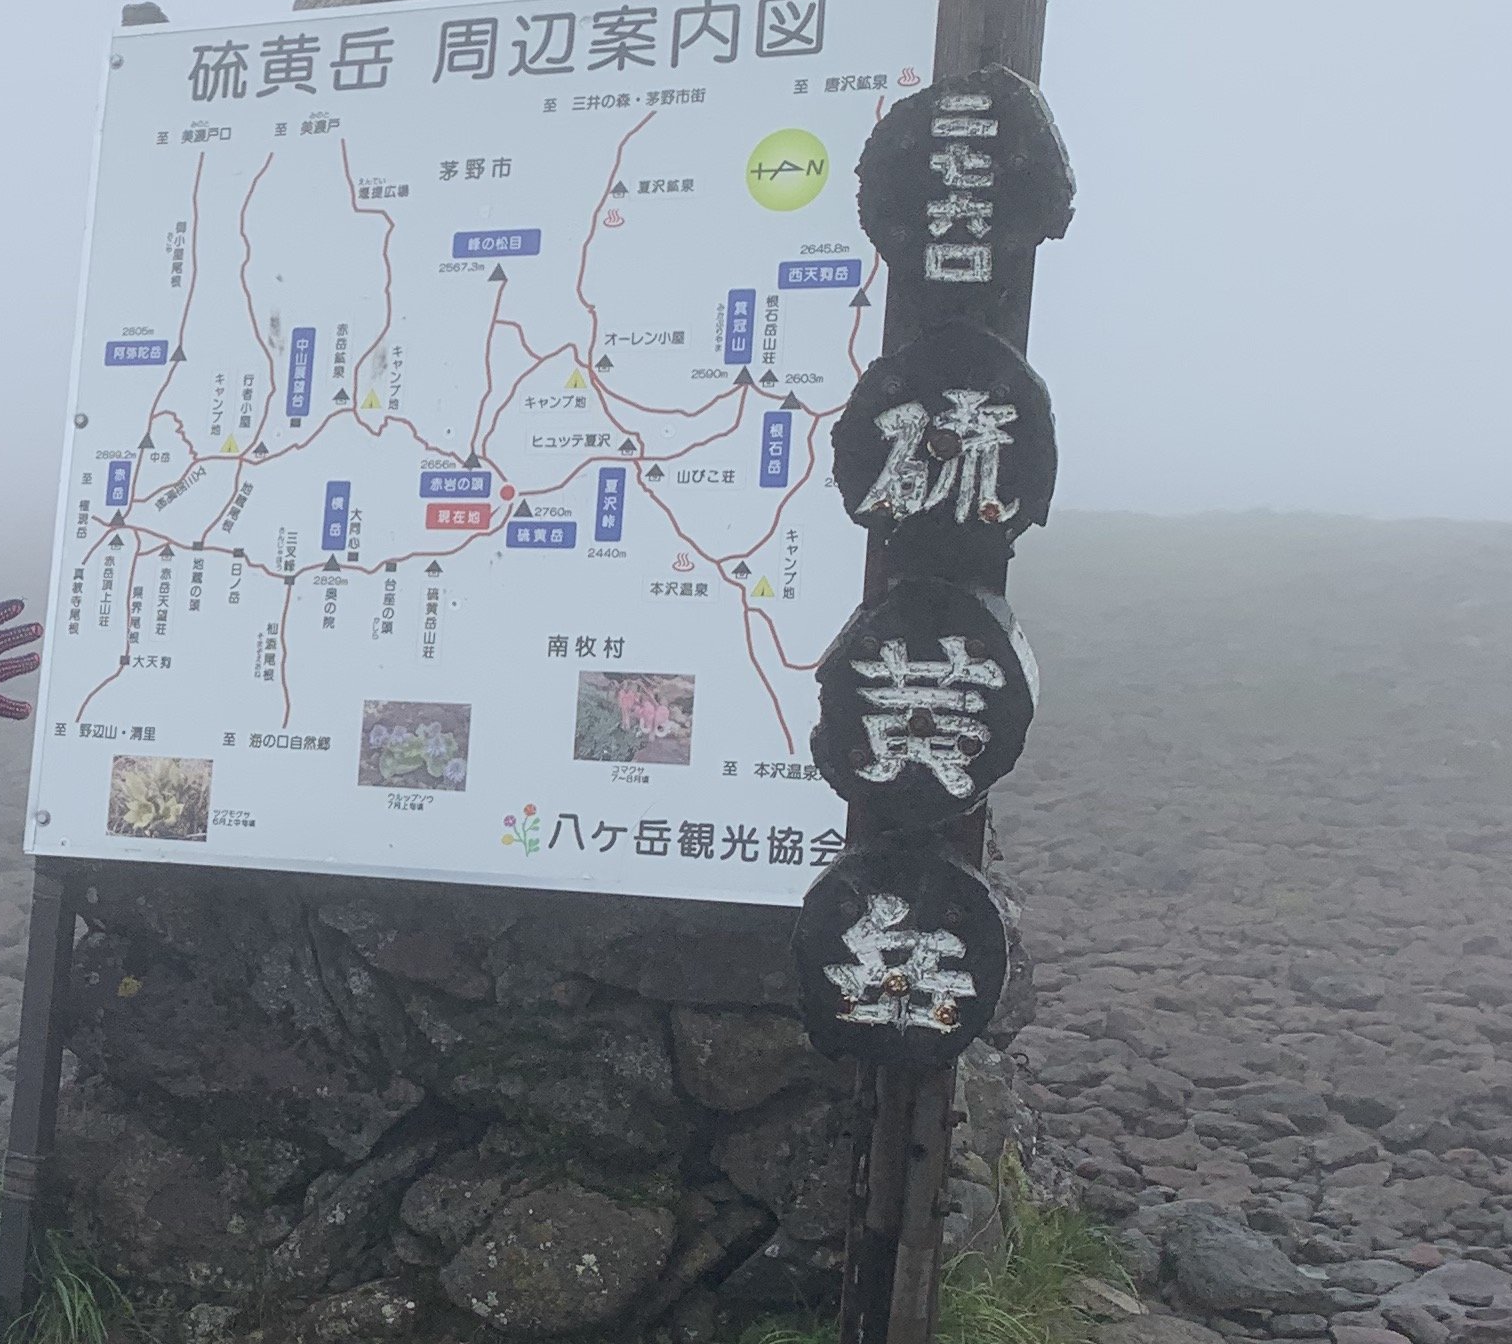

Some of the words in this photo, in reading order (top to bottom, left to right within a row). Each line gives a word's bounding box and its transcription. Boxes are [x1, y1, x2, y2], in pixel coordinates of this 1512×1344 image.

[188, 26, 395, 102] 硫黄岳
[793, 79, 808, 94] 至
[825, 74, 888, 93] 唐沢鉱泉
[543, 98, 557, 113] 至
[572, 88, 706, 111] 三井の森・茅野市街
[275, 122, 288, 136] 至
[156, 131, 169, 145] 至
[439, 157, 512, 181] 茅野市
[637, 179, 694, 194] 夏沢鉱泉
[800, 243, 850, 255] 2645.8m
[122, 326, 154, 337] 2805m
[603, 331, 685, 346] オーレン小屋
[762, 295, 779, 365] 根石岳山荘
[387, 345, 403, 410] キャンプ地
[785, 373, 824, 384] 2603m
[210, 373, 225, 436] キャンプ地
[238, 374, 255, 429] 行者小屋
[524, 395, 587, 409] キャンプ地
[532, 434, 611, 448] ヒュッテ夏沢
[767, 423, 785, 475] 根石岳
[430, 477, 484, 492] 赤岩の頭
[677, 470, 736, 485] 山びこ荘
[534, 507, 572, 517] 2760m
[601, 479, 619, 529] 夏沢峠
[437, 509, 481, 524] 現在地
[348, 508, 363, 550] 大同心
[517, 529, 564, 543] 硫黄岳
[587, 548, 627, 559] 2440m
[782, 528, 799, 600] キャンプ地
[313, 576, 349, 586] 2829m
[650, 582, 709, 597] 本沢温泉
[98, 555, 116, 628] 赤岳頂上山荘
[322, 587, 337, 630] 奥の院
[421, 587, 440, 659] 硫黄岳山荘
[547, 634, 626, 659] 南牧村
[54, 722, 67, 737] 至
[79, 723, 156, 742] 野辺山・清里
[222, 732, 236, 746] 至
[722, 760, 738, 777] 至
[753, 761, 824, 782] 本沢温泉
